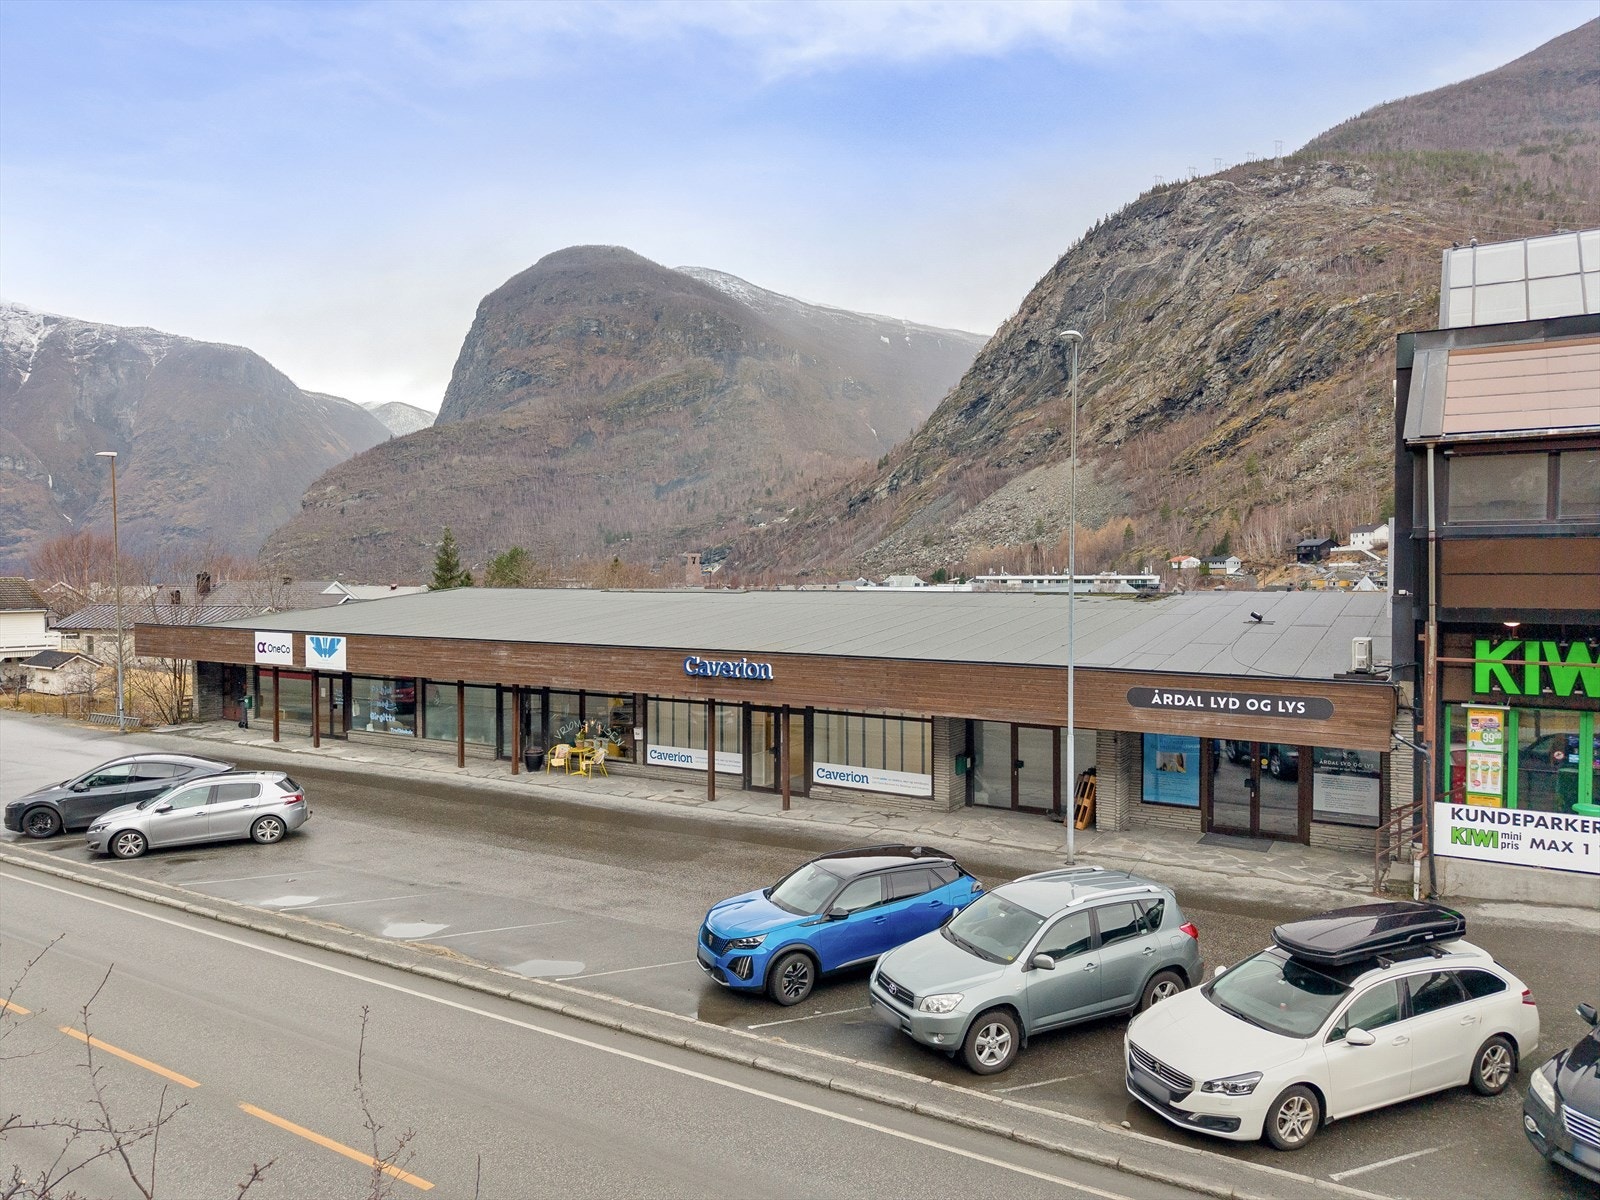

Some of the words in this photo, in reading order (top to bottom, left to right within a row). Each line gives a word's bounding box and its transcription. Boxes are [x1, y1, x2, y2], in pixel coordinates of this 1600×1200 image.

[267, 643, 291, 654] OneCo
[683, 656, 774, 680] Caverion
[1151, 689, 1204, 708] ÅRDAL
[1210, 696, 1240, 709] LYD
[1246, 698, 1272, 712] OG
[1278, 701, 1306, 714] LYS
[649, 749, 693, 763] Caverion
[1319, 758, 1339, 766] ÅRDAL
[816, 767, 870, 784] Caverion
[1451, 826, 1499, 849] KIWI
[1501, 831, 1522, 841] mini
[1500, 840, 1520, 851] pris
[1530, 837, 1574, 854] MAX
[1583, 843, 1589, 855] 1
